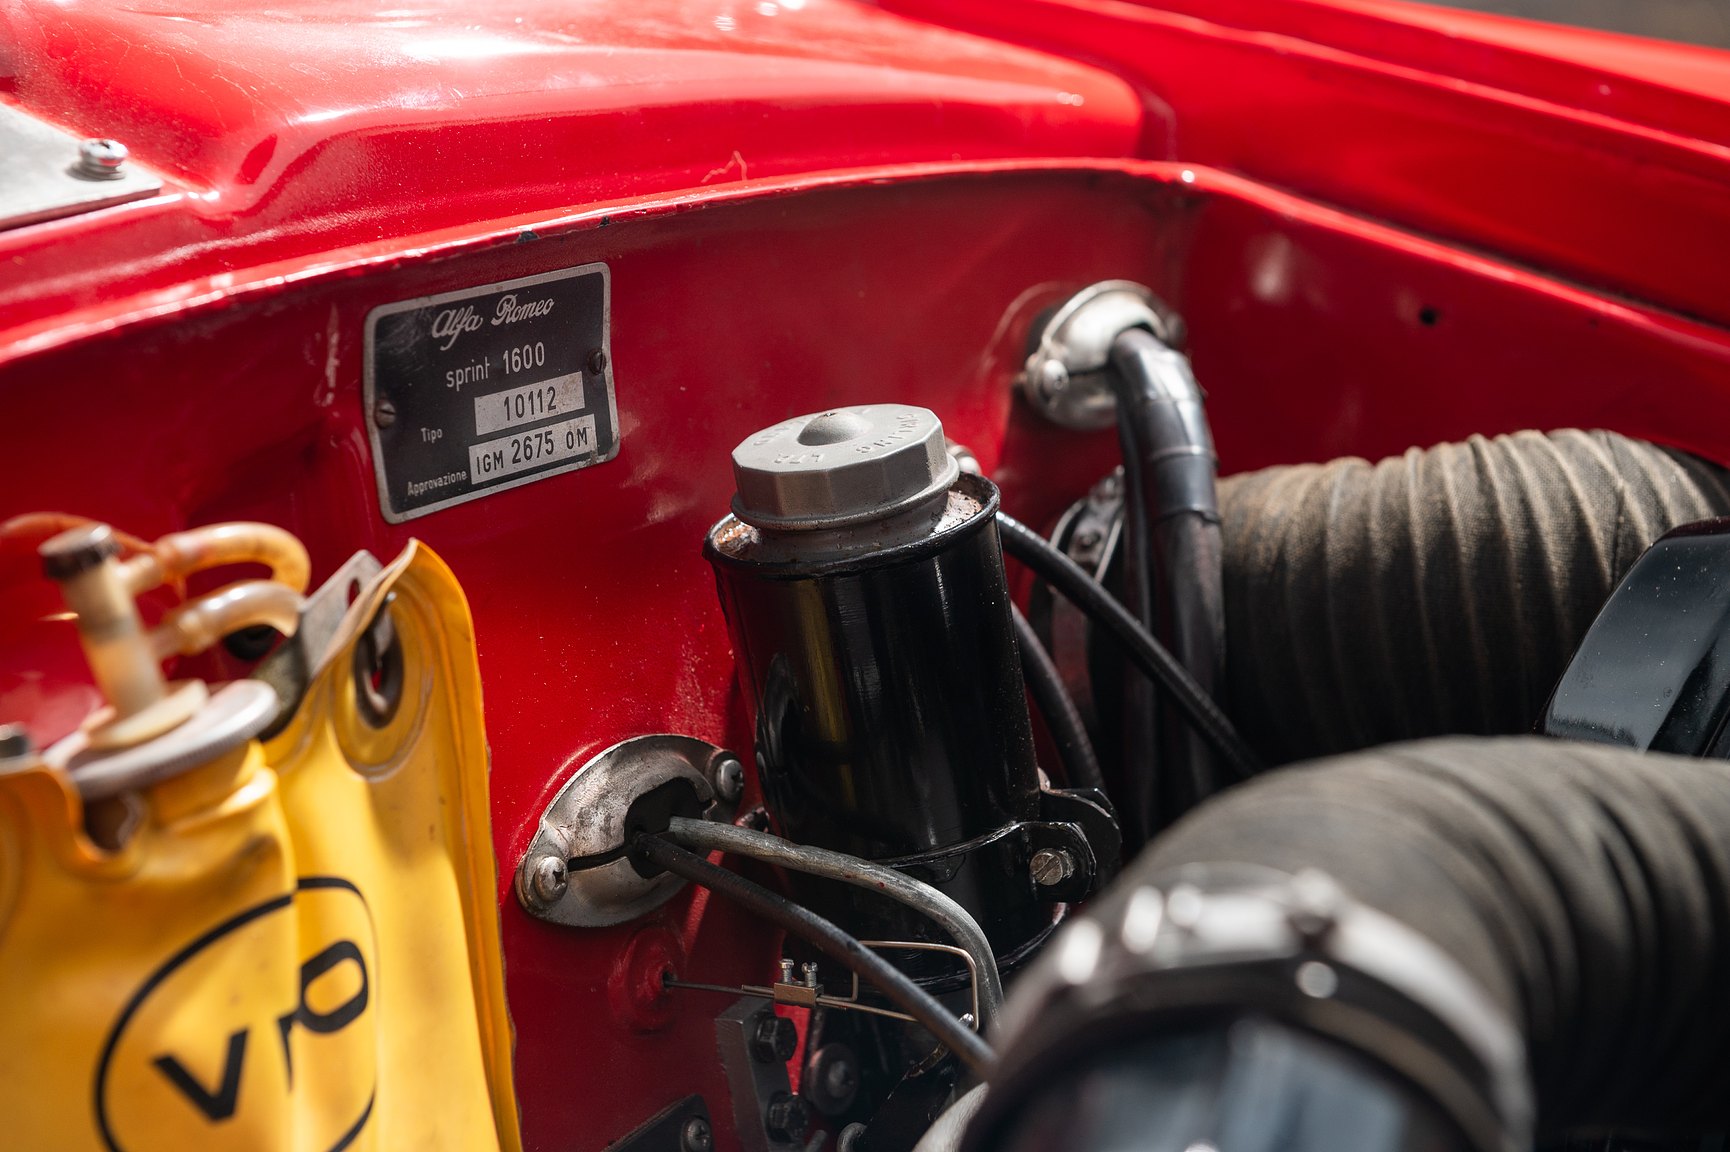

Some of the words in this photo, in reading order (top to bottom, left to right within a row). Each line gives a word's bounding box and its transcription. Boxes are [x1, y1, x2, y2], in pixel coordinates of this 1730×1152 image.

[431, 305, 483, 351] Alfa
[491, 294, 555, 326] Romeo
[446, 356, 490, 392] sprint
[502, 341, 545, 375] 1600
[420, 426, 443, 444] Tipo
[503, 386, 557, 421] 10112
[407, 469, 468, 497] Approvazione
[476, 449, 504, 475] IGM
[511, 430, 555, 465] 2675
